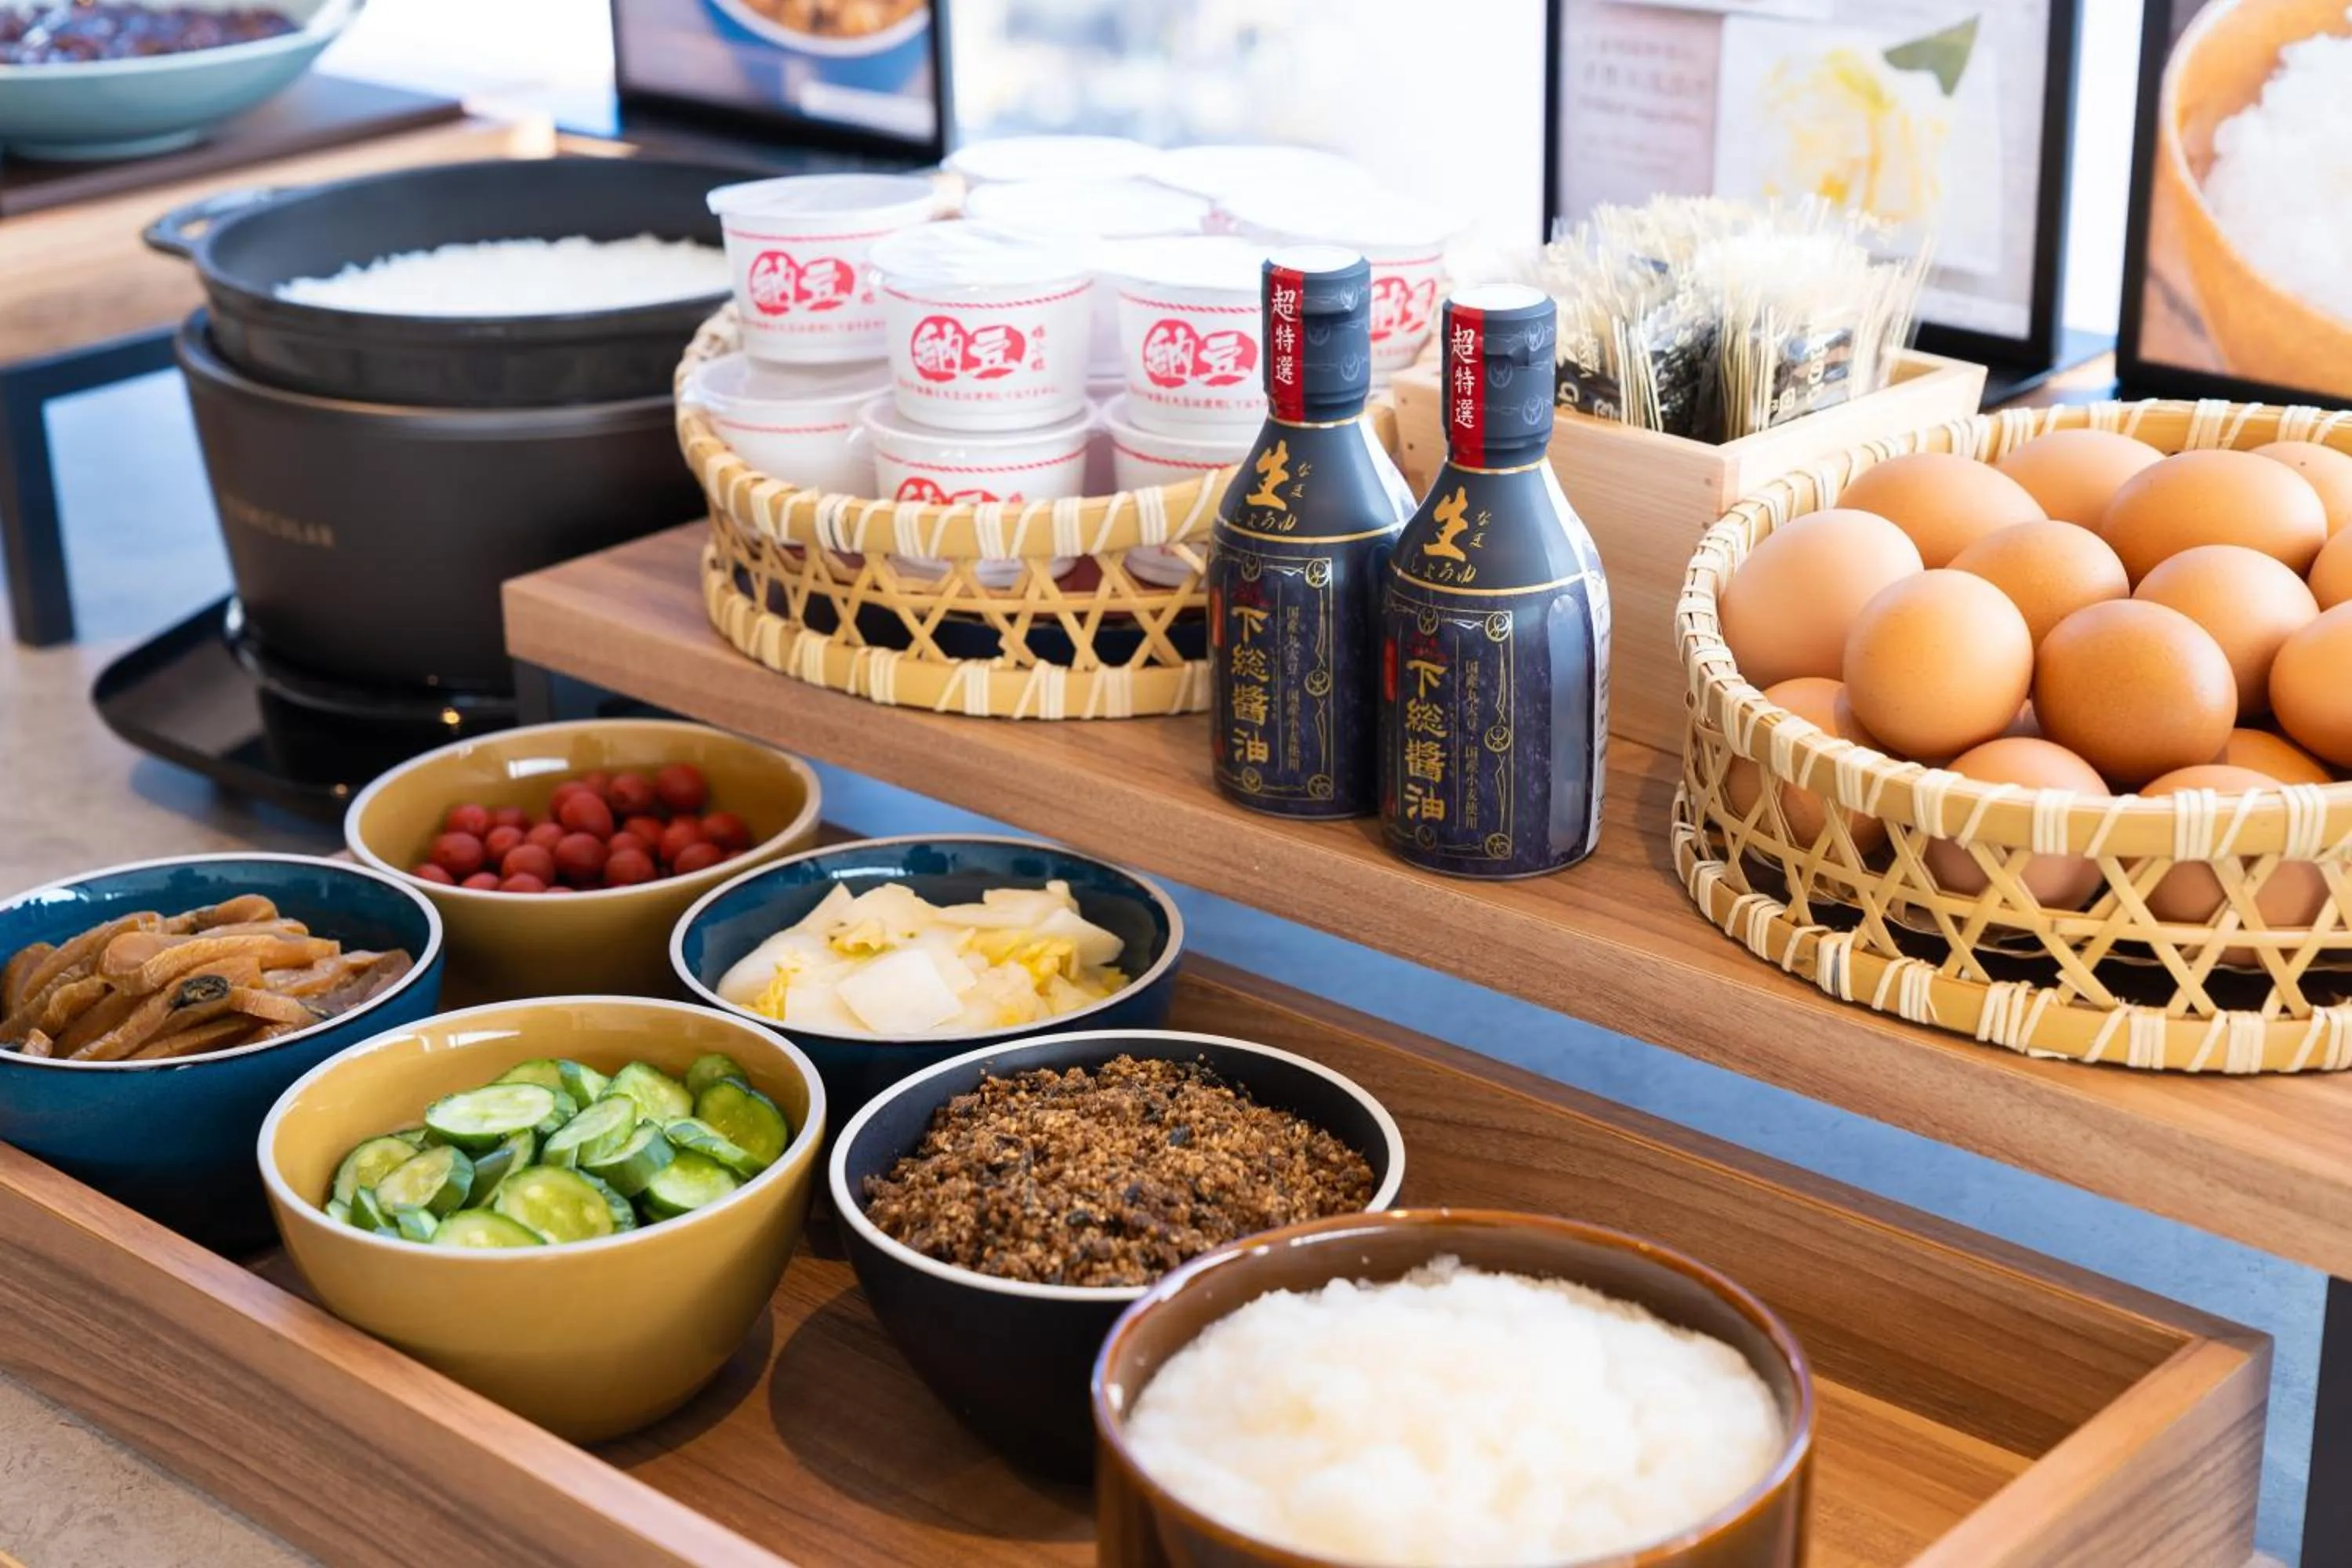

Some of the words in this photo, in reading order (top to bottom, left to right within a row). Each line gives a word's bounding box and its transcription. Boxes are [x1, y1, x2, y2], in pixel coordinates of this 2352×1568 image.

[750, 250, 855, 316] 納豆
[911, 315, 1025, 382] 納豆
[1142, 319, 1258, 387] 納豆
[1272, 284, 1298, 385] 超特選
[1451, 323, 1478, 429] 超特選
[1245, 439, 1290, 511] 生
[1423, 485, 1468, 562] 生
